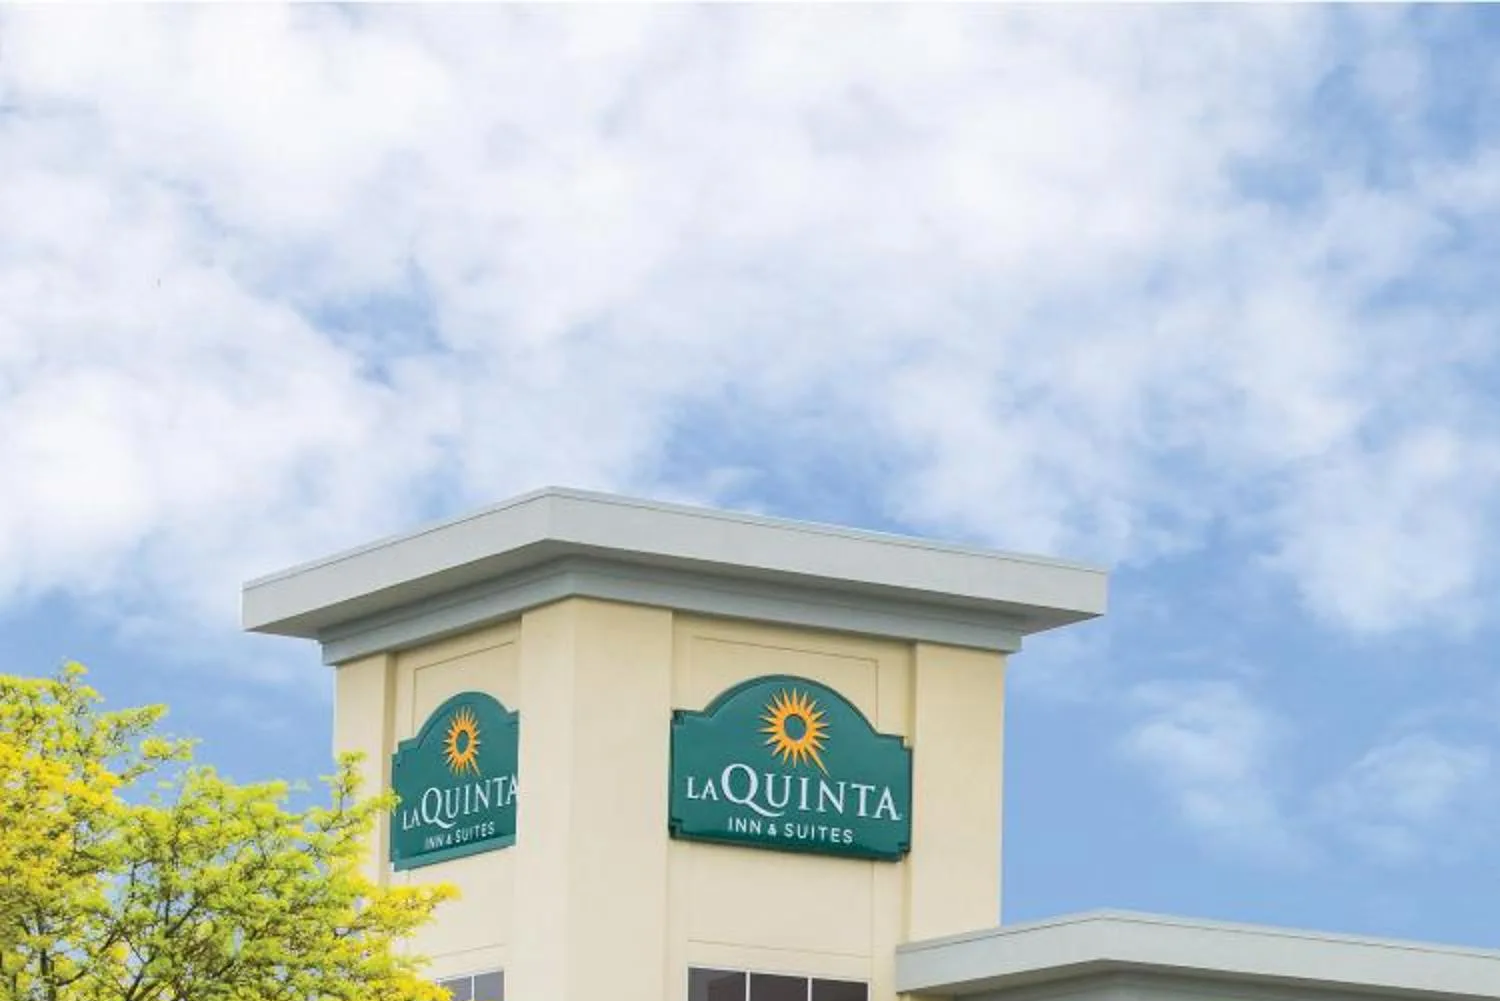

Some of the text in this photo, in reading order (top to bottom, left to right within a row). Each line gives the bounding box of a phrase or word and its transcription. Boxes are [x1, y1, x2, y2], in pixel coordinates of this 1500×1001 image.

[455, 821, 495, 844] SUITES
[727, 816, 854, 845] INN & SUITES
